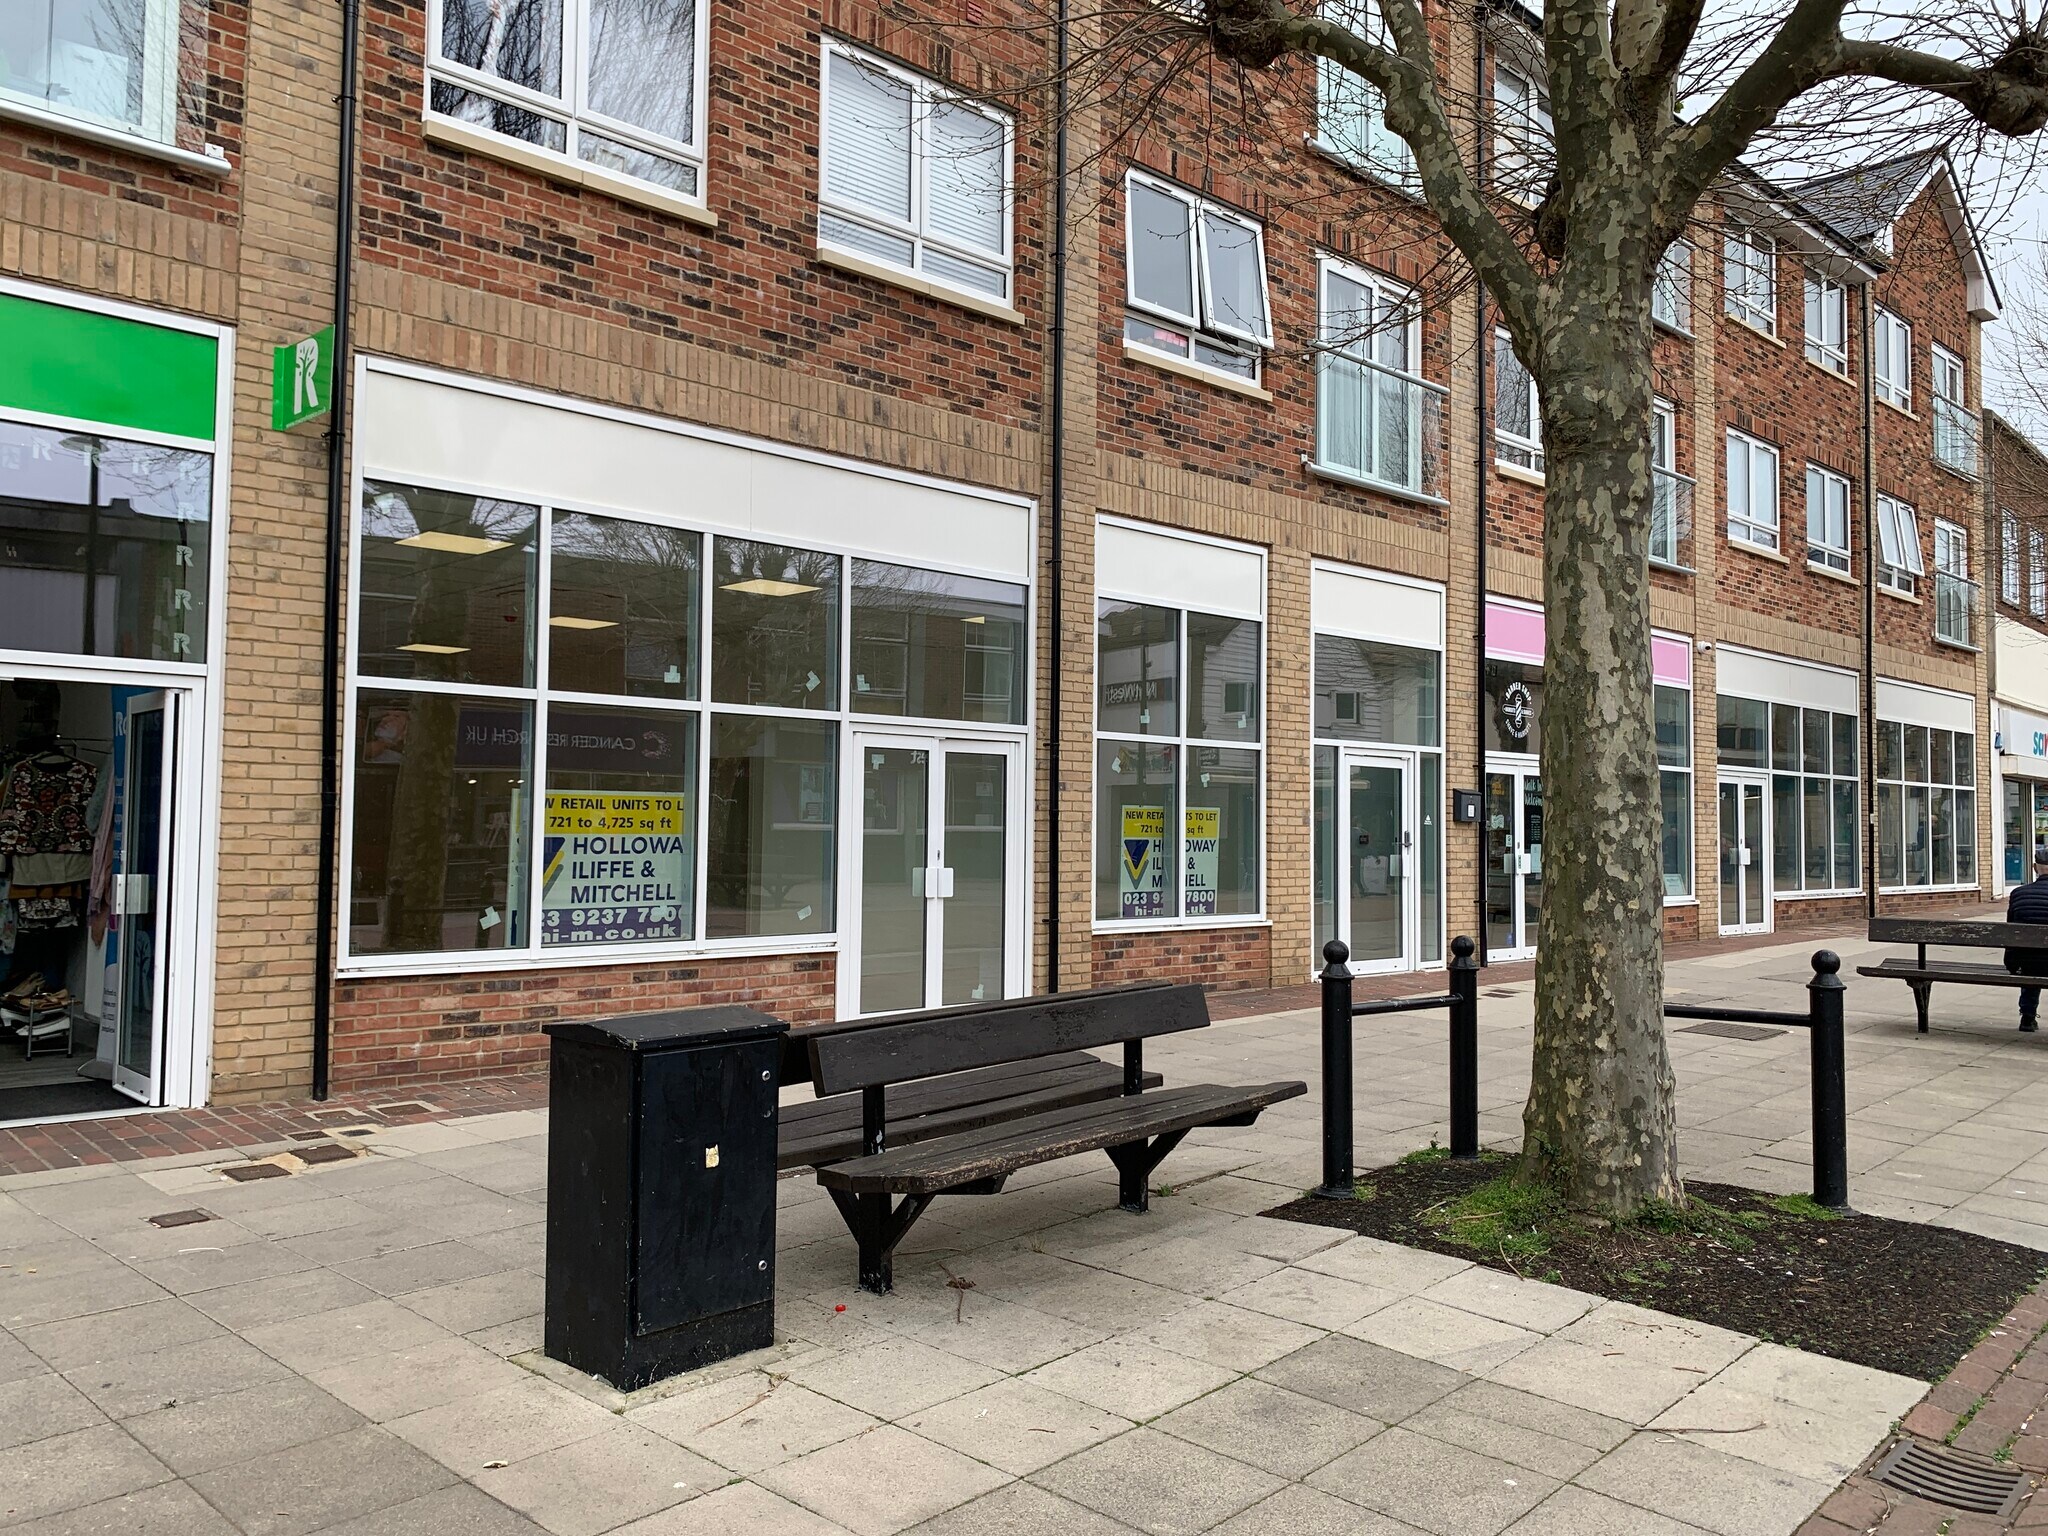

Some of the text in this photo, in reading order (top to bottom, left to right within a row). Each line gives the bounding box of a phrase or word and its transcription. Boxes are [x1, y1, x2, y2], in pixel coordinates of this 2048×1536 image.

[561, 798, 606, 810] RETAIL
[612, 799, 650, 810] UNITS
[656, 800, 672, 810] TO
[1524, 793, 1543, 807] Welcom
[550, 816, 672, 830] 721 to 4,725 sq ft
[1125, 811, 1144, 820] NEW
[1147, 811, 1164, 820] RETA
[1195, 812, 1204, 820] TO
[1206, 813, 1217, 821] LET
[1140, 825, 1204, 835] 721 to sq ft
[573, 836, 684, 855] HOLLOWA
[572, 860, 656, 879] ILIFFE &
[1188, 857, 1195, 870] &
[571, 884, 676, 904] MITCHELL
[1124, 893, 1147, 905] 023
[1186, 891, 1214, 902] 7800
[572, 908, 627, 926] 9237
[638, 905, 682, 923] 780
